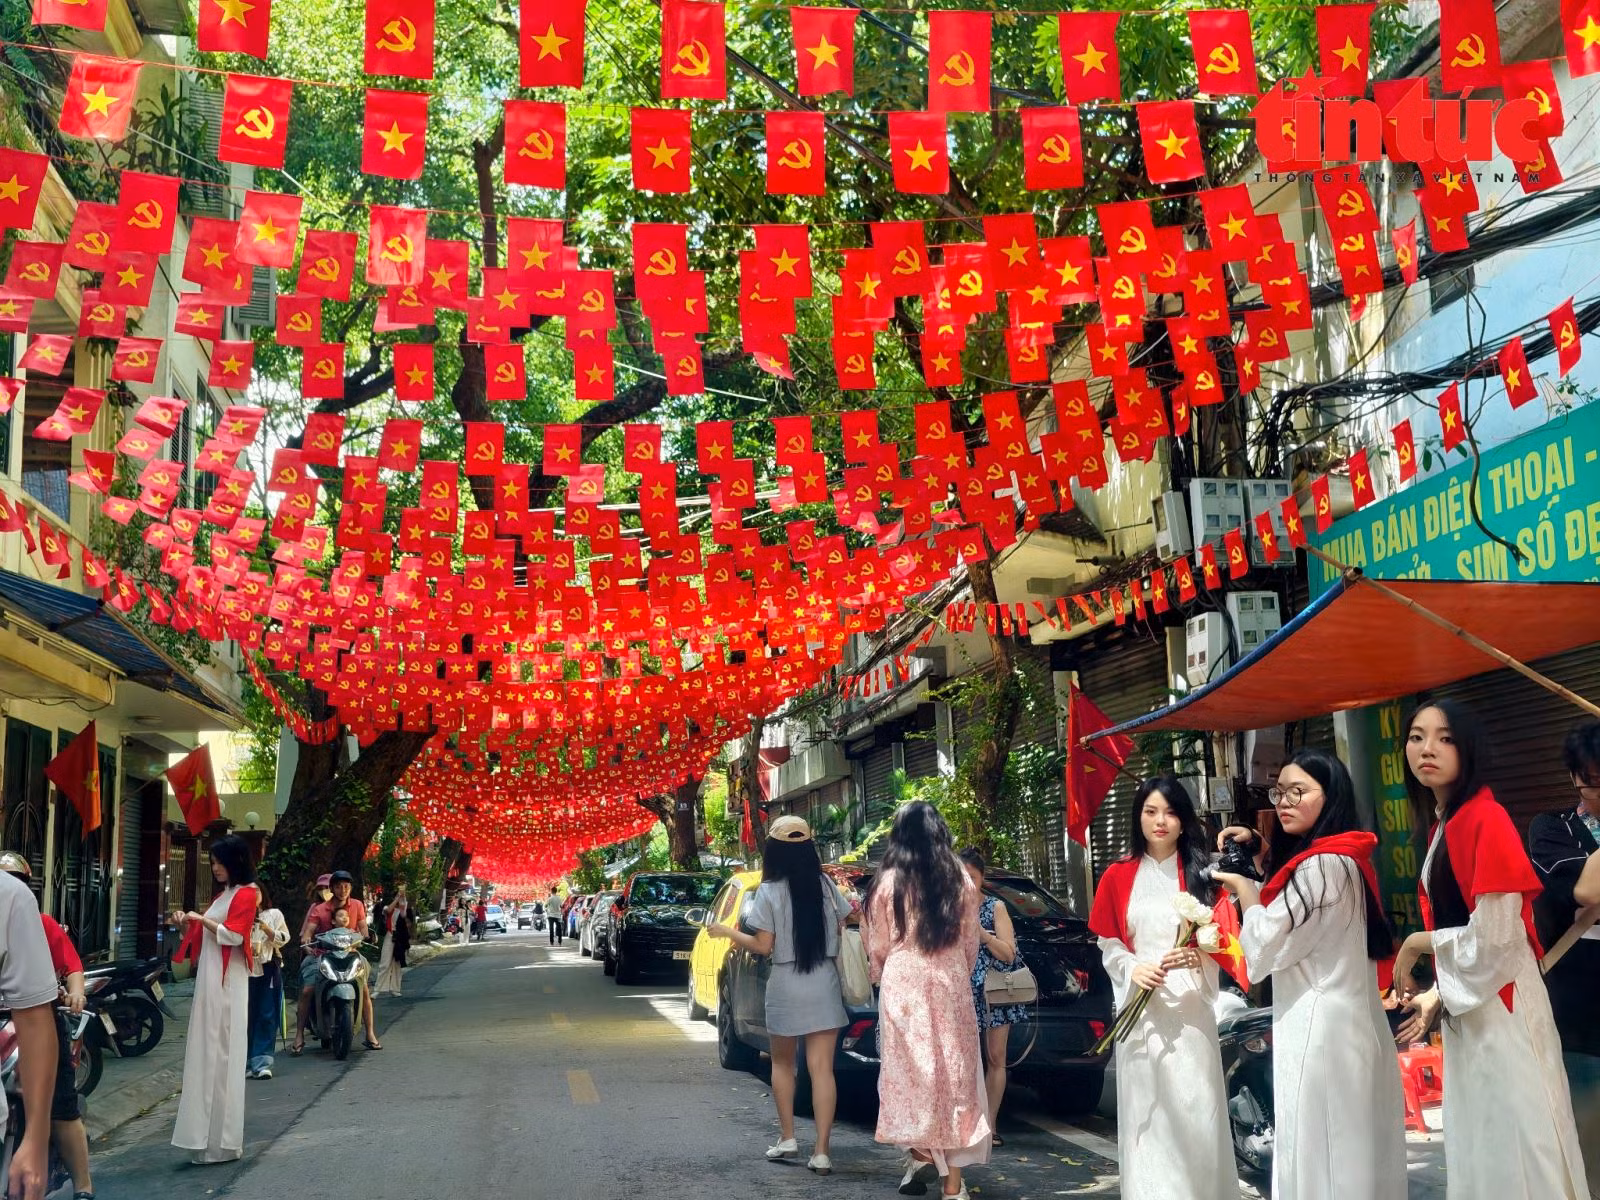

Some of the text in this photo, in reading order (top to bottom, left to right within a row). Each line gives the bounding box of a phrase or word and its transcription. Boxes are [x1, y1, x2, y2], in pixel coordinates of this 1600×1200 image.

[1322, 528, 1367, 583] MUA
[1371, 503, 1418, 563] BÁN
[1423, 476, 1483, 543] ĐIỆN
[1515, 502, 1557, 576] SỐ
